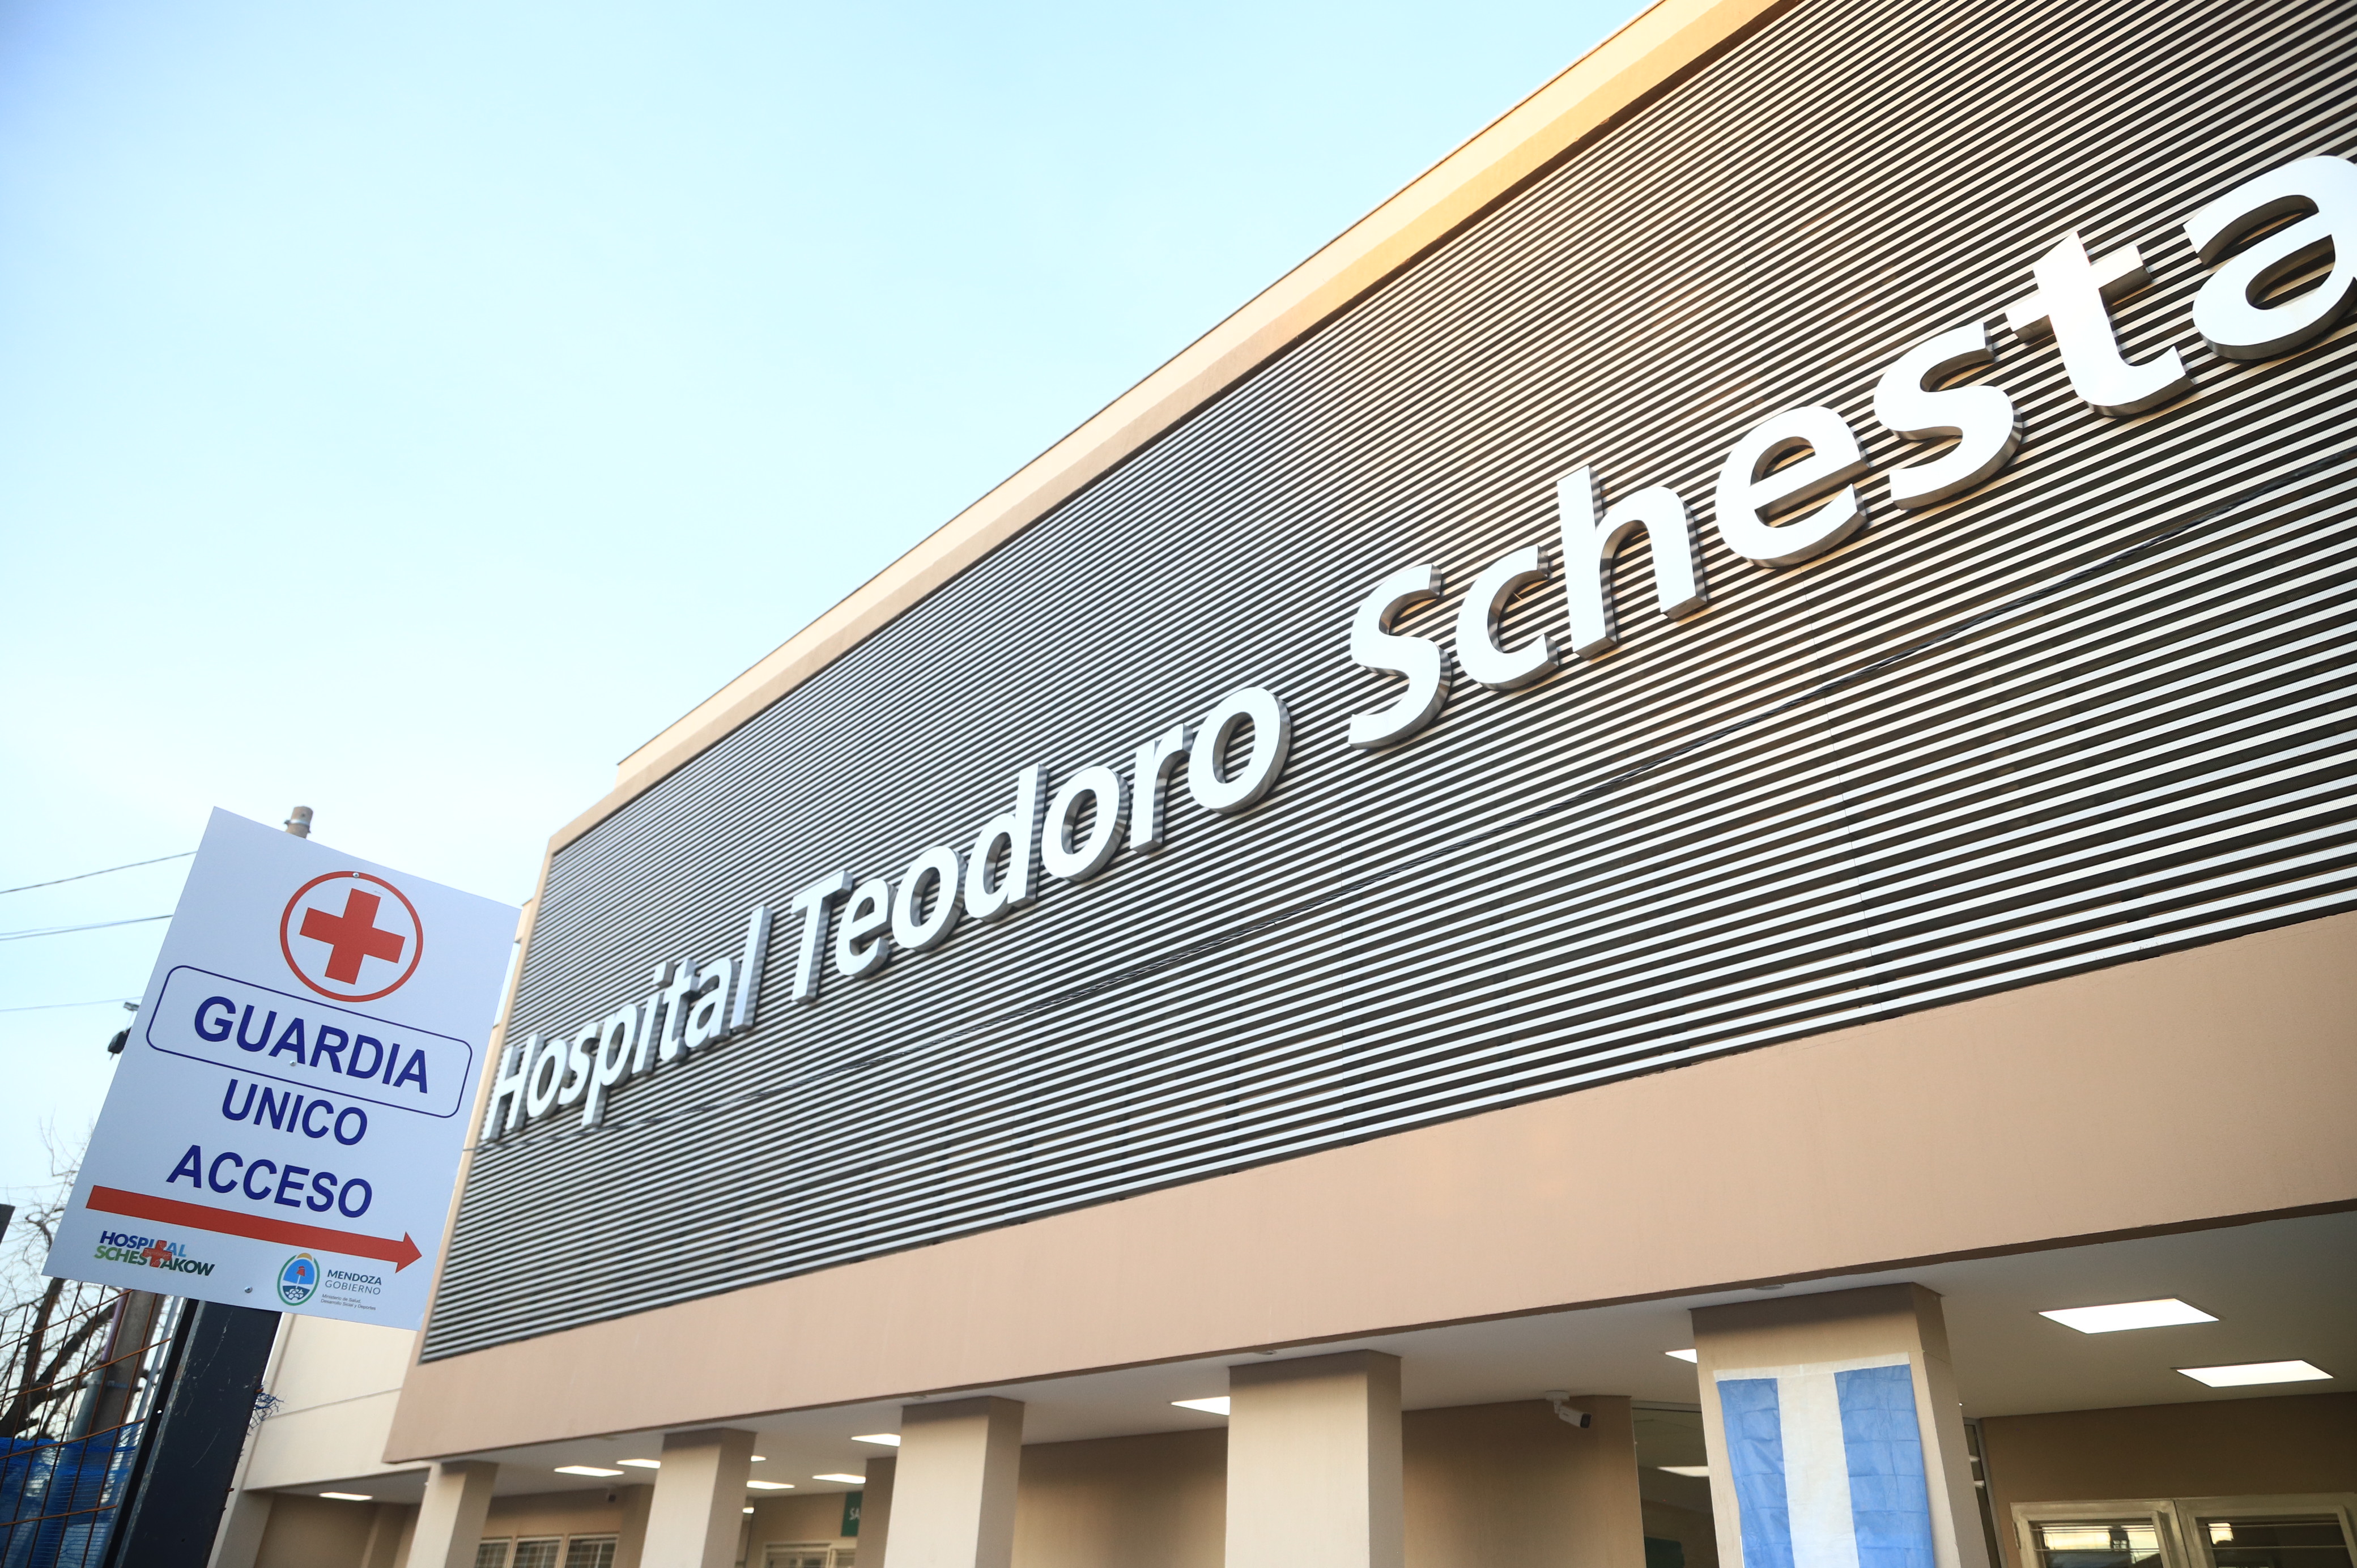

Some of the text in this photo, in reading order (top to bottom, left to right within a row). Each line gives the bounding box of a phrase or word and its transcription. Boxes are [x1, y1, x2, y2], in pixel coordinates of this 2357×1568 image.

[480, 155, 2357, 1142] Hospital Teodoro Schesta
[194, 996, 429, 1094] GUARDIA
[222, 1079, 368, 1146] UNICO
[165, 1144, 373, 1218] ACCESO
[93, 1245, 216, 1276] SCHESAKOW
[99, 1230, 187, 1258] HOSPIAL
[325, 1280, 381, 1295] GOBIERNO
[327, 1269, 382, 1286] MENDOZA
